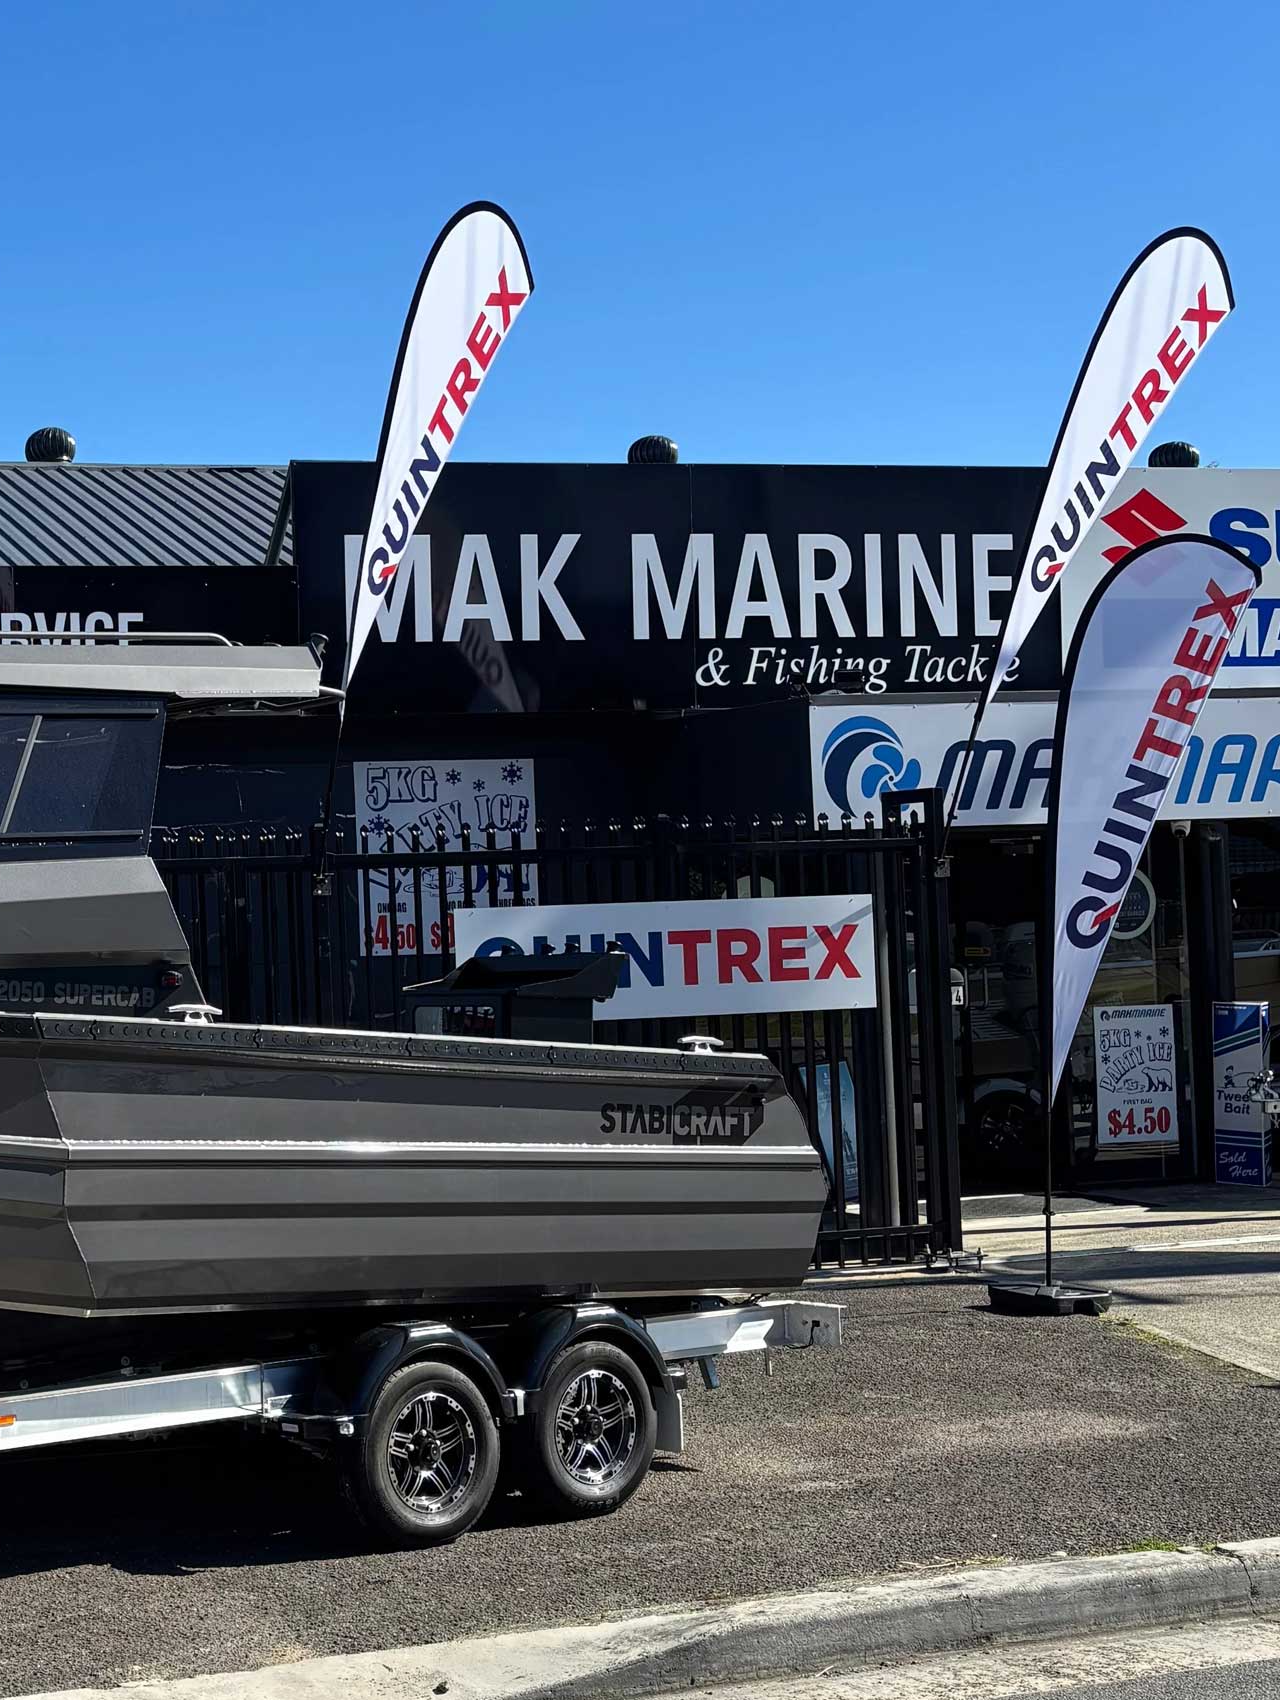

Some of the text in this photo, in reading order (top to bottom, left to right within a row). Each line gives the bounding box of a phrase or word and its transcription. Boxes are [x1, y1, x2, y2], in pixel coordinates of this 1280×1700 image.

[367, 265, 528, 596] QUINTREX
[1031, 283, 1227, 593] QUINTREX
[631, 532, 1014, 641] MARINE
[695, 647, 731, 687] &
[905, 644, 1021, 683] Tacke
[1066, 578, 1252, 949] QUINTREX
[366, 766, 438, 812] 5KG
[54, 982, 155, 1008] SUPERCAB
[1099, 1029, 1132, 1052] 5KG
[1099, 1042, 1173, 1093] PARTY ICE
[1216, 1089, 1249, 1102] Twee
[1224, 1102, 1251, 1115] Bait
[600, 1102, 755, 1137] STABICRAFT
[1108, 1106, 1171, 1138] $4.50
[1219, 1151, 1247, 1164] Sold
